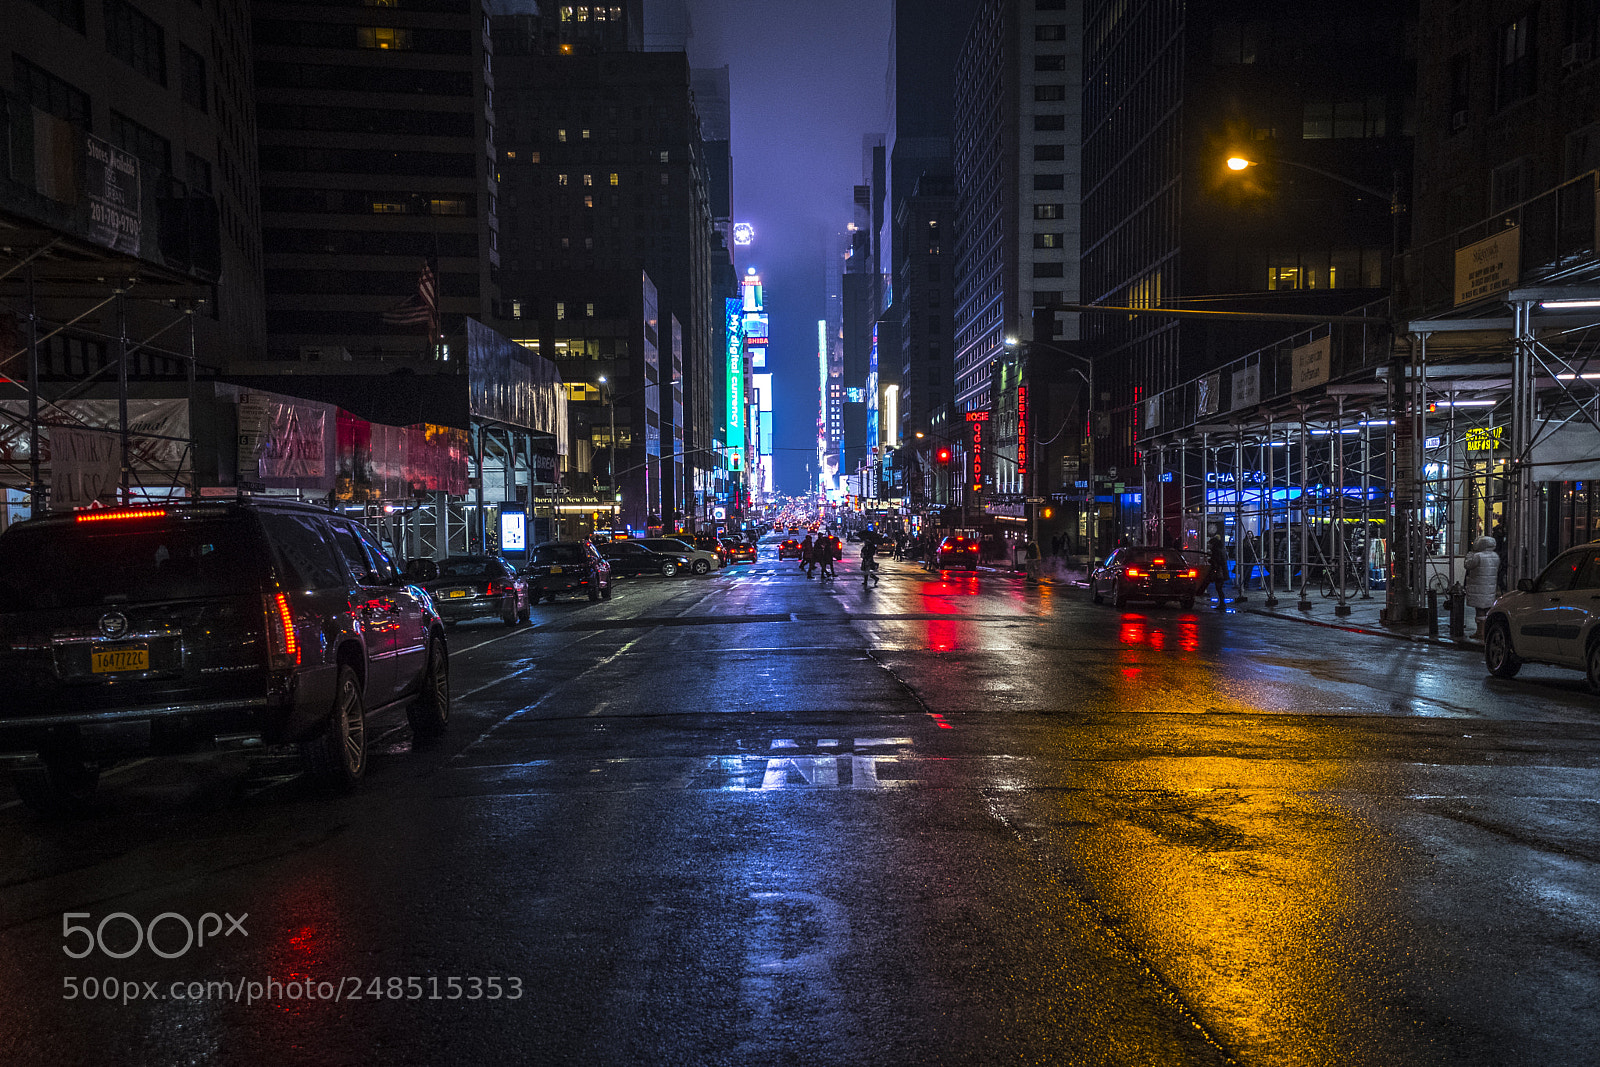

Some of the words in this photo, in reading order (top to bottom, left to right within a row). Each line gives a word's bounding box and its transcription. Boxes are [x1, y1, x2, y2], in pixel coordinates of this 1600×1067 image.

[729, 314, 739, 333] My
[730, 335, 740, 373] digital
[730, 376, 739, 428] currency
[965, 411, 989, 422] ROSIE
[1017, 386, 1026, 468] RESTAURANT
[97, 651, 144, 668] T647722C
